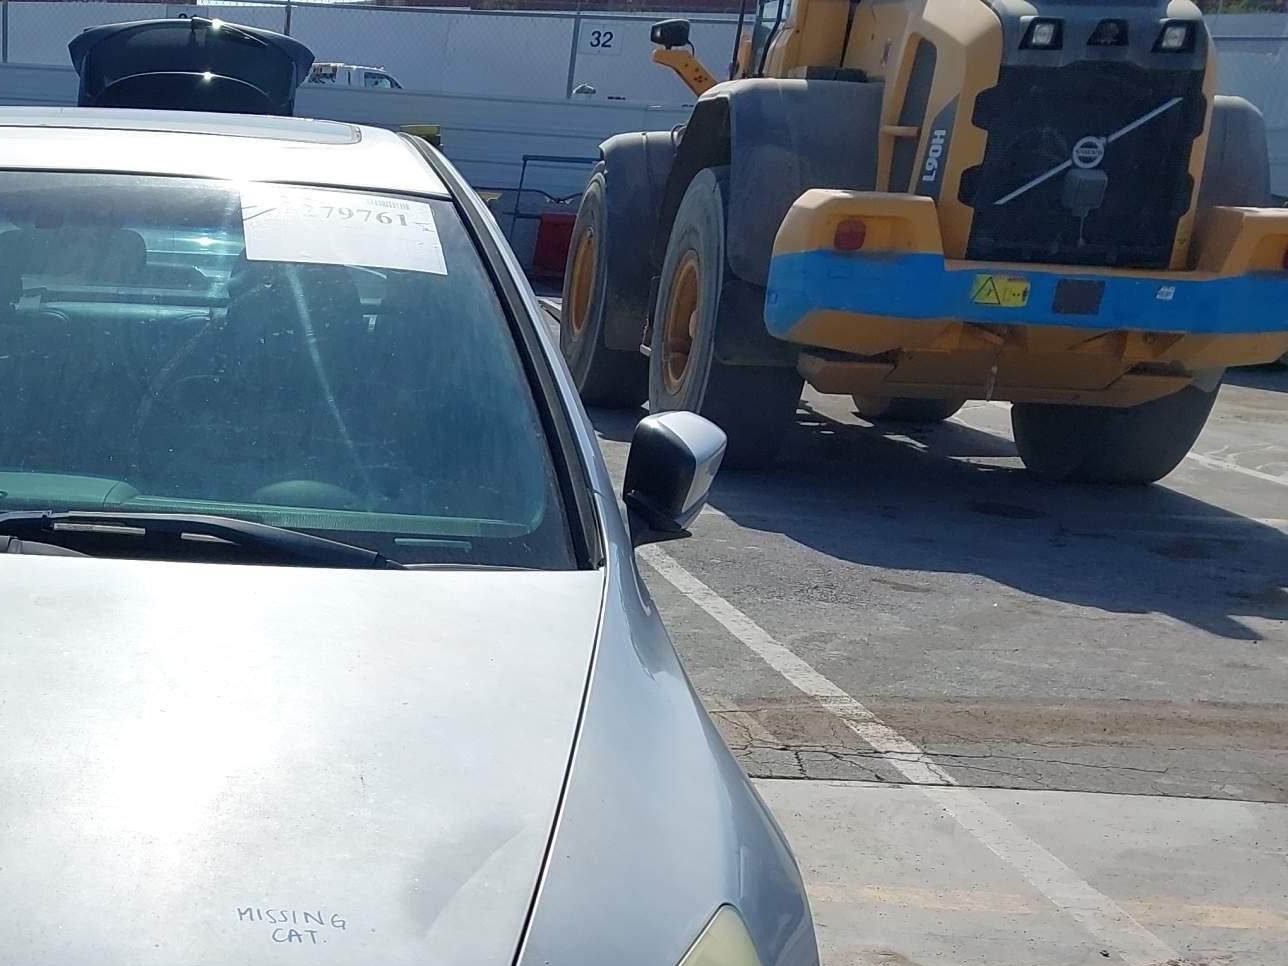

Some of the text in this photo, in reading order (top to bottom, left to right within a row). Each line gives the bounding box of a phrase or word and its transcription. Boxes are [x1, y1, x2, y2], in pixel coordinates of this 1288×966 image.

[590, 30, 614, 48] 32
[922, 129, 947, 182] L90H
[236, 907, 347, 930] MISSING
